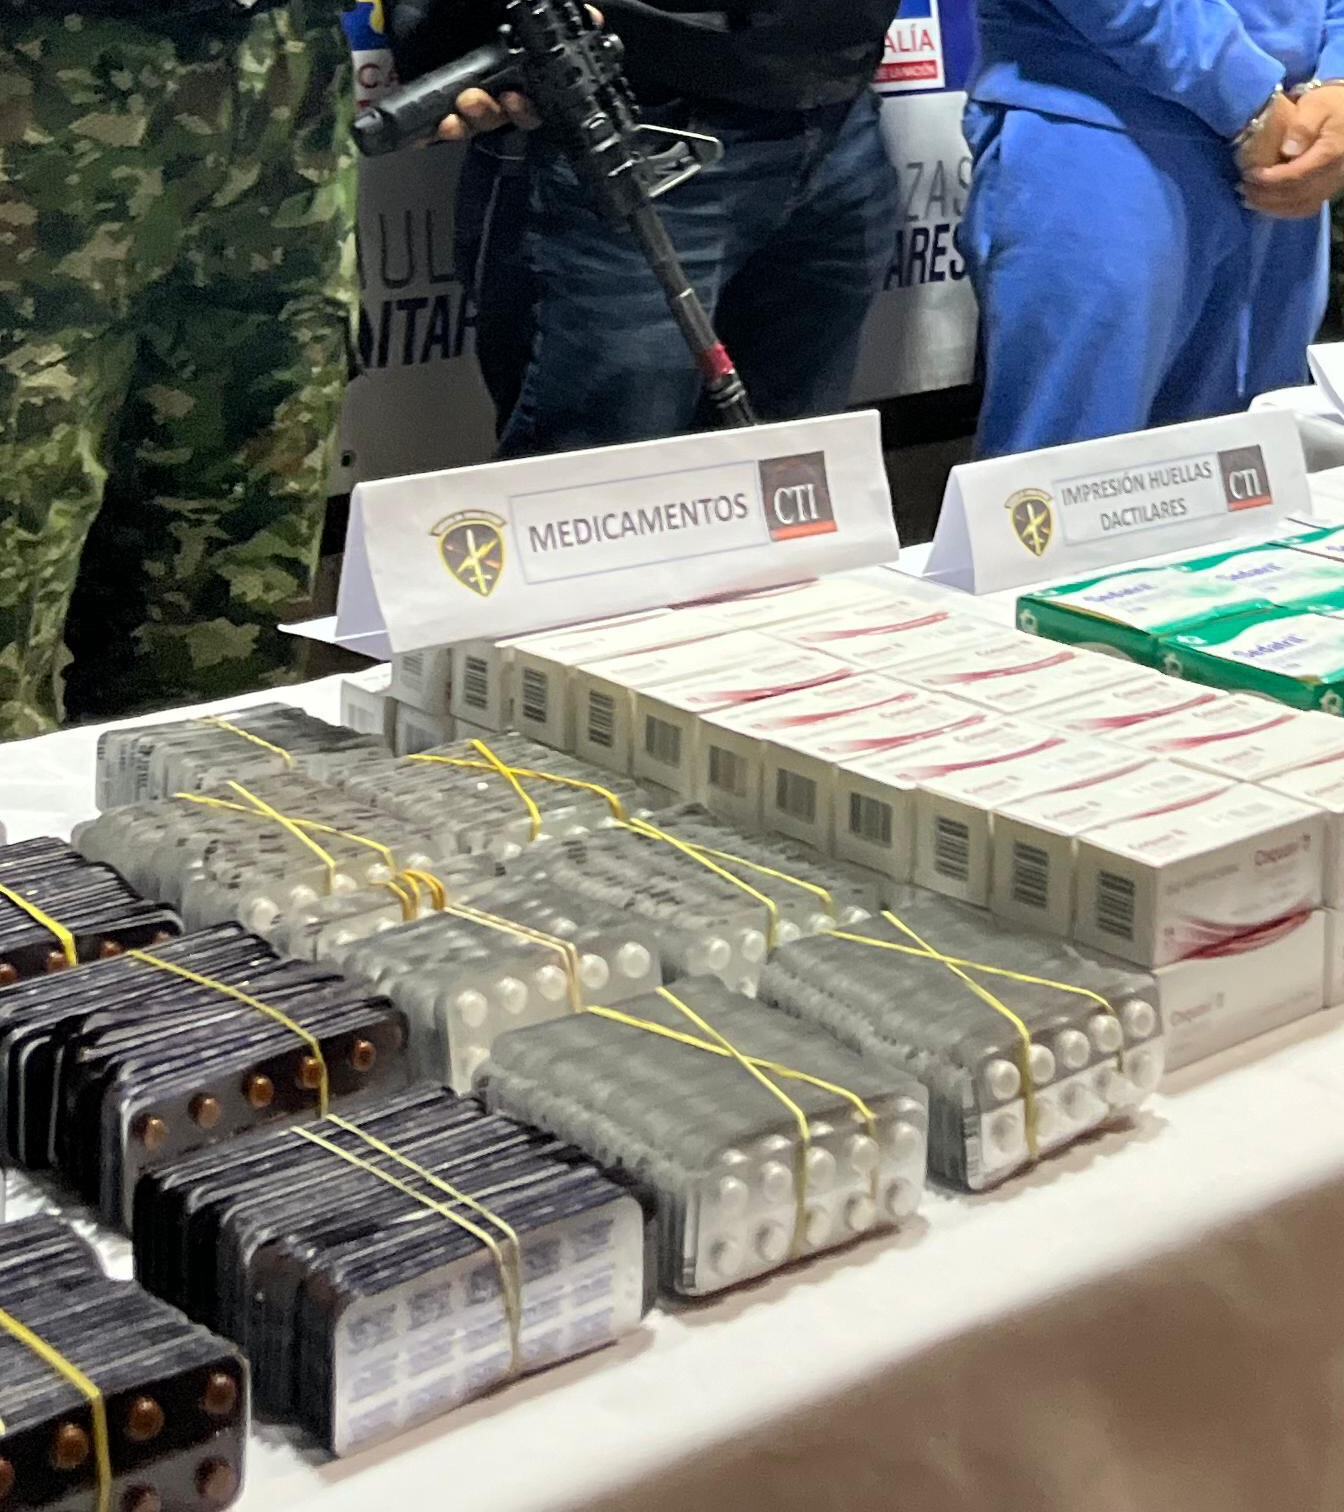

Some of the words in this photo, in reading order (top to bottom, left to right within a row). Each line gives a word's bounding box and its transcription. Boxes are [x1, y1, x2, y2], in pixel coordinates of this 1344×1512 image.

[1061, 469, 1146, 506] IMPRESIÓN
[1148, 461, 1213, 491] HUELLAS
[528, 492, 750, 554] MEDICAMENTOS
[773, 483, 820, 526] CTI
[1100, 496, 1188, 532] DACTILARES
